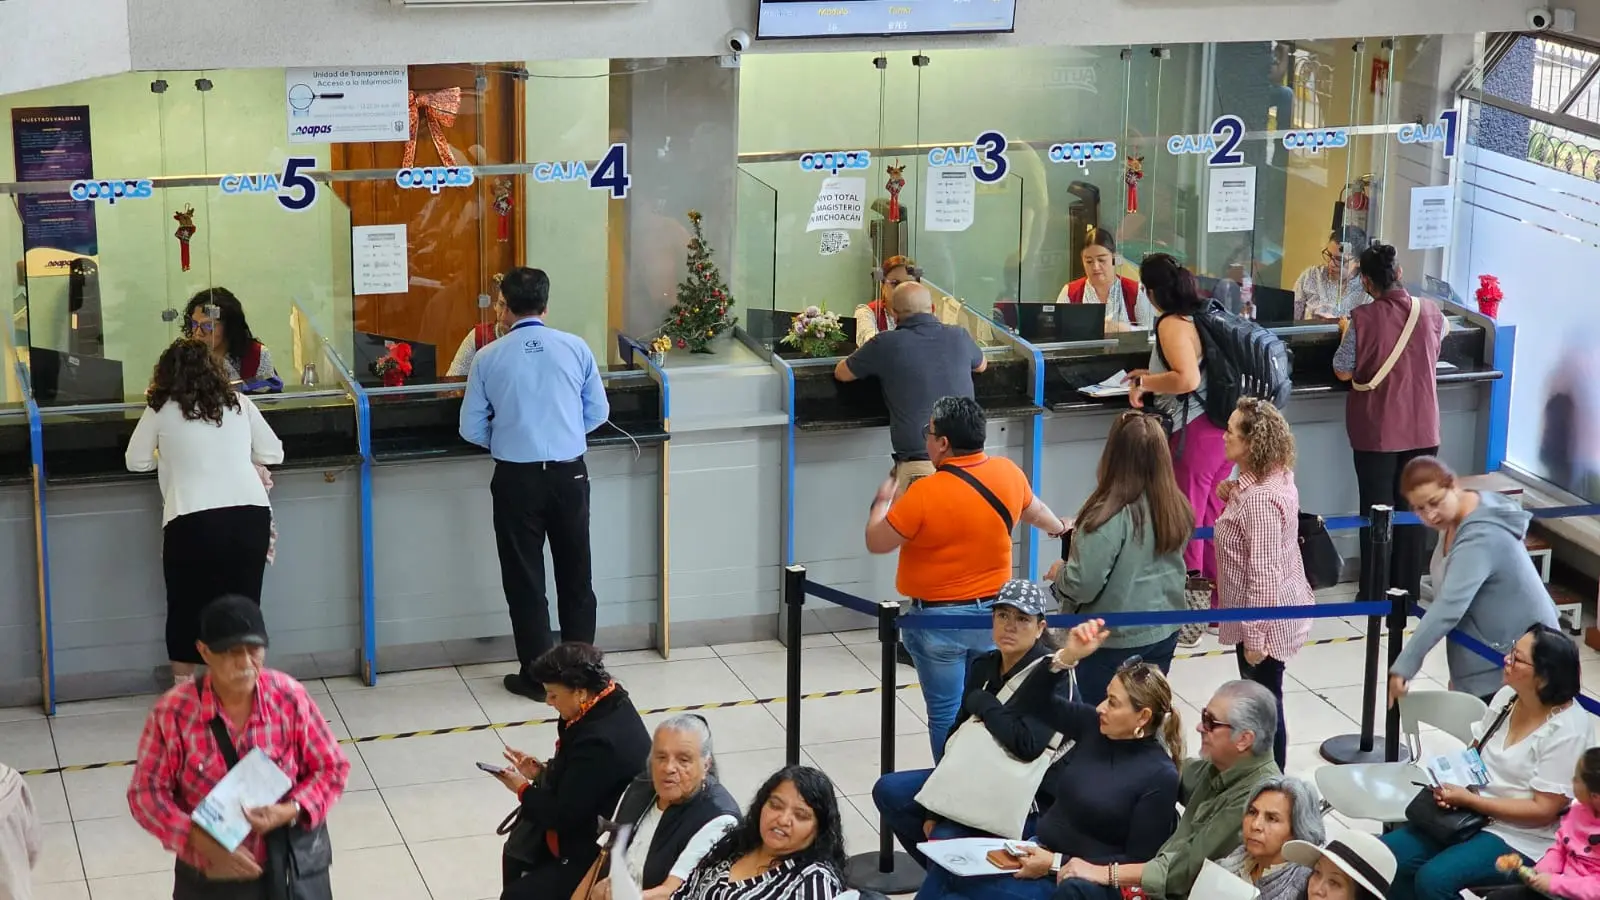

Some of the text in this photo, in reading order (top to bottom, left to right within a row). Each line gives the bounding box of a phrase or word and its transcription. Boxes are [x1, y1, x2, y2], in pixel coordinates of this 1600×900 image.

[350, 69, 400, 77] Transparencia
[929, 132, 1007, 181] CAJA 3
[1168, 118, 1243, 164] CAJA 2
[1399, 111, 1457, 156] CAJA 1
[221, 158, 316, 209] CAJA 5
[534, 145, 629, 196] CAJA 4
